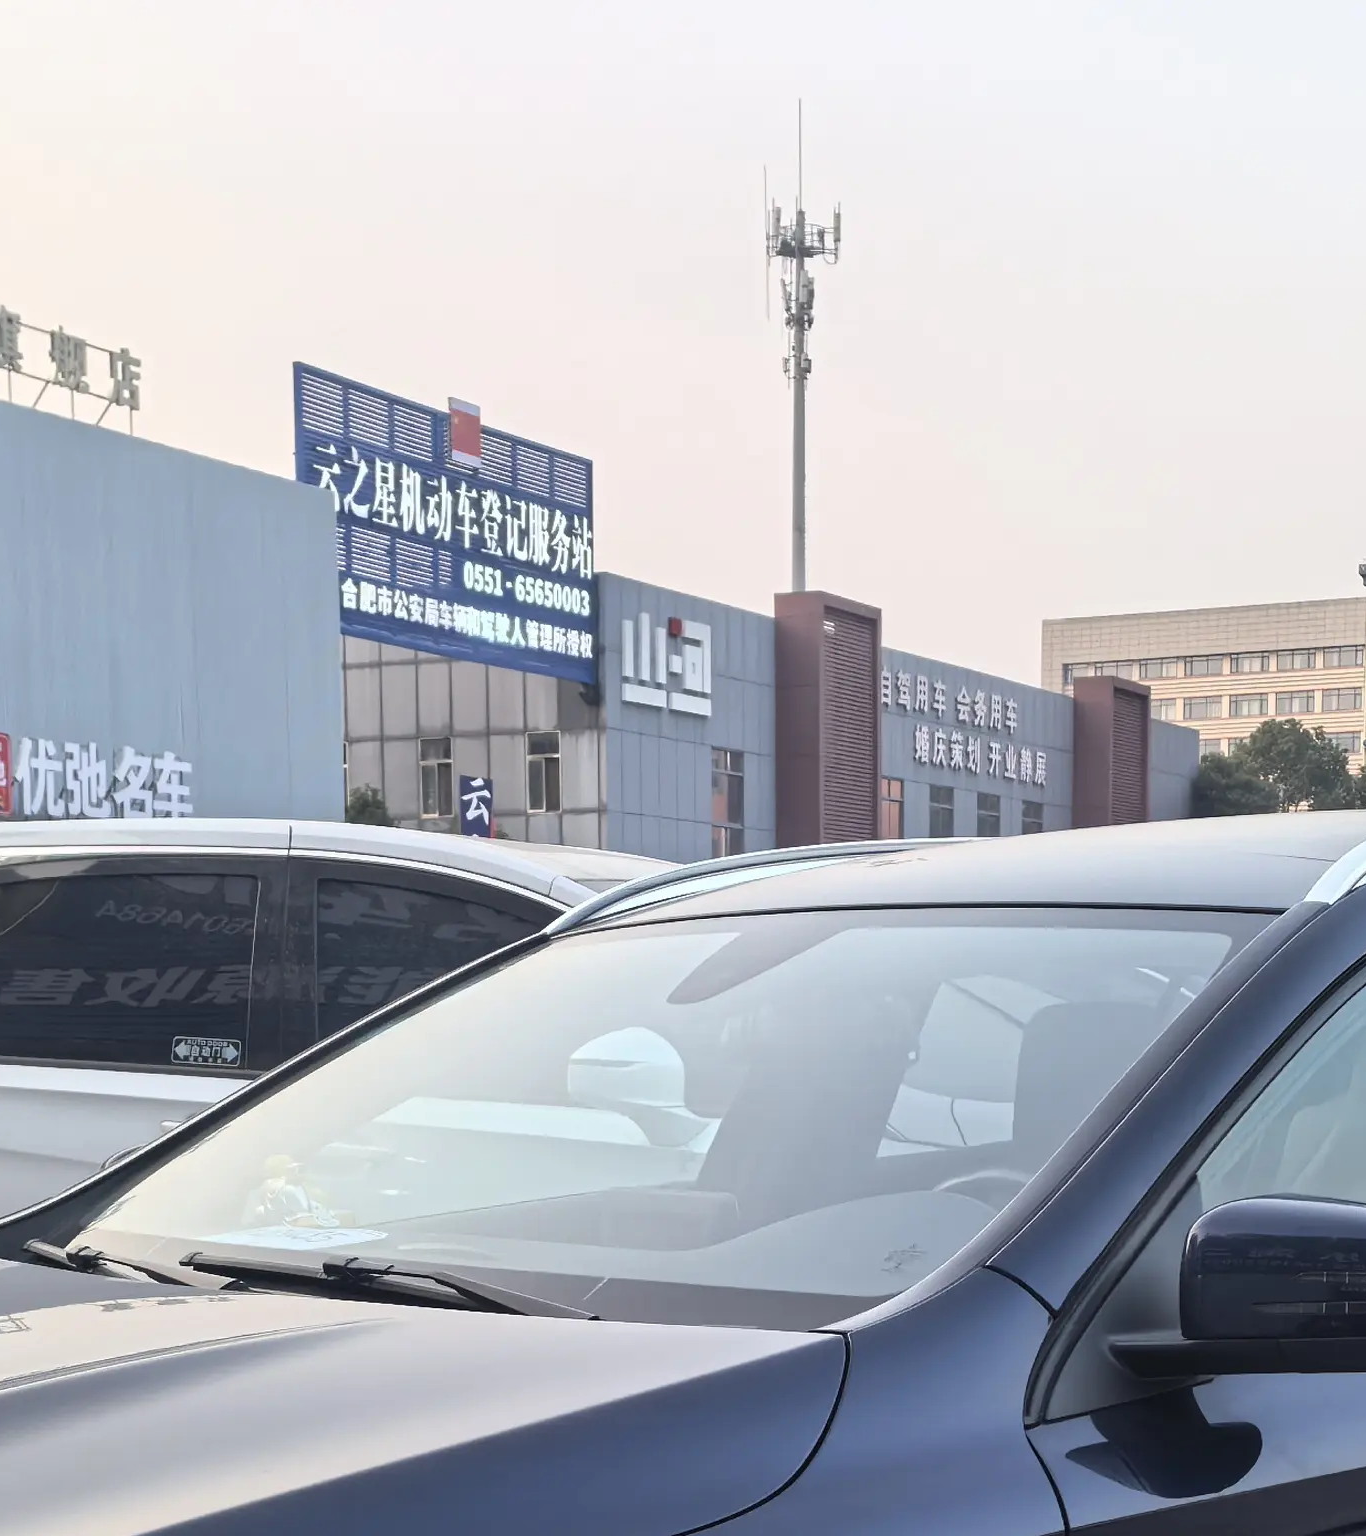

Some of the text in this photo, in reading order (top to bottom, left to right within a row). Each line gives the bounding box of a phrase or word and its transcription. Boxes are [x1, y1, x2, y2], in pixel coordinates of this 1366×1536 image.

[341, 578, 594, 659] 合肥市公安局车辆和驾驶人管理所授权
[880, 665, 1018, 735] 自驾用车 会务用车
[14, 737, 194, 818] 优弛名车
[913, 724, 1047, 787] 婚庆策划 开业静展
